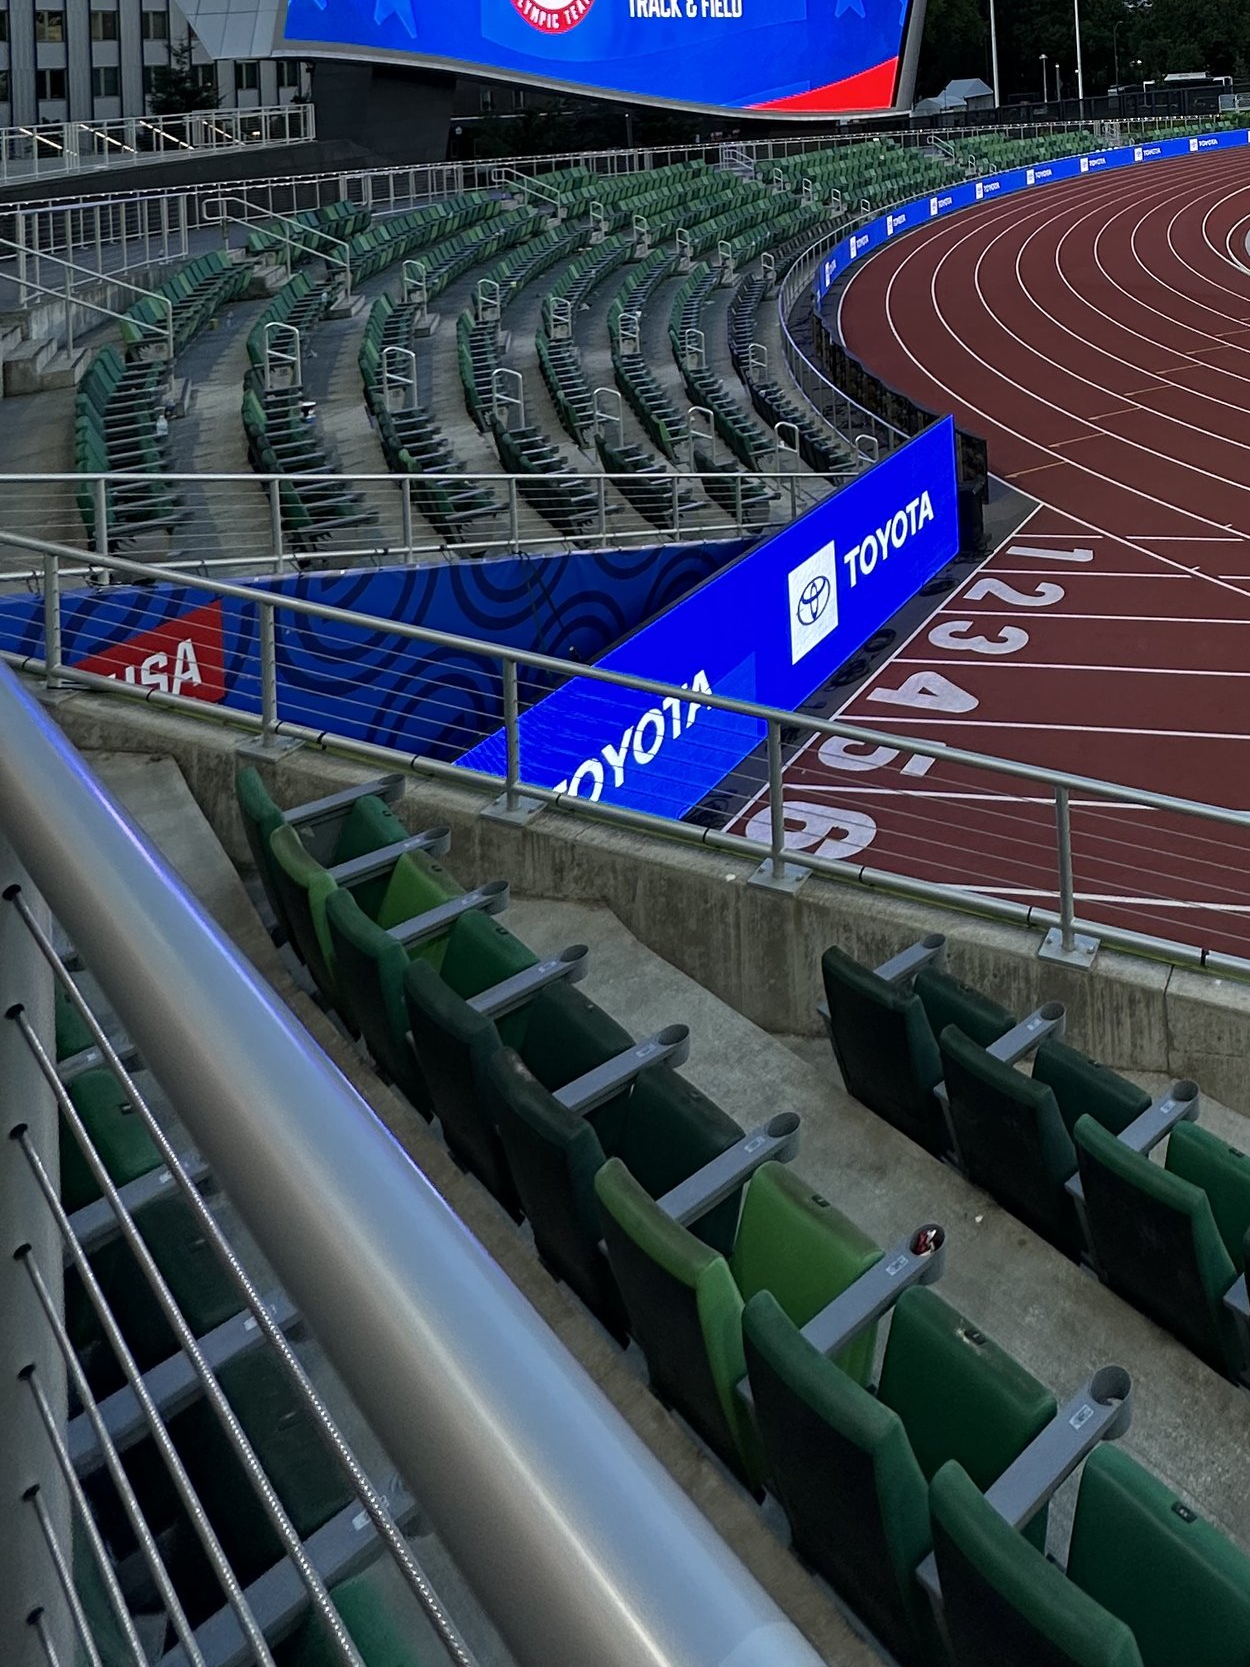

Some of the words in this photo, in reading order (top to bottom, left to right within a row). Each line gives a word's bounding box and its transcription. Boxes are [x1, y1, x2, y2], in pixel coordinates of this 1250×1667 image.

[843, 489, 935, 589] TOYOTA
[1005, 545, 1094, 563] 1
[963, 577, 1066, 607] 2
[927, 620, 1030, 655] 3
[107, 638, 202, 695] SA
[866, 670, 980, 714] 4
[745, 800, 877, 861] 6
